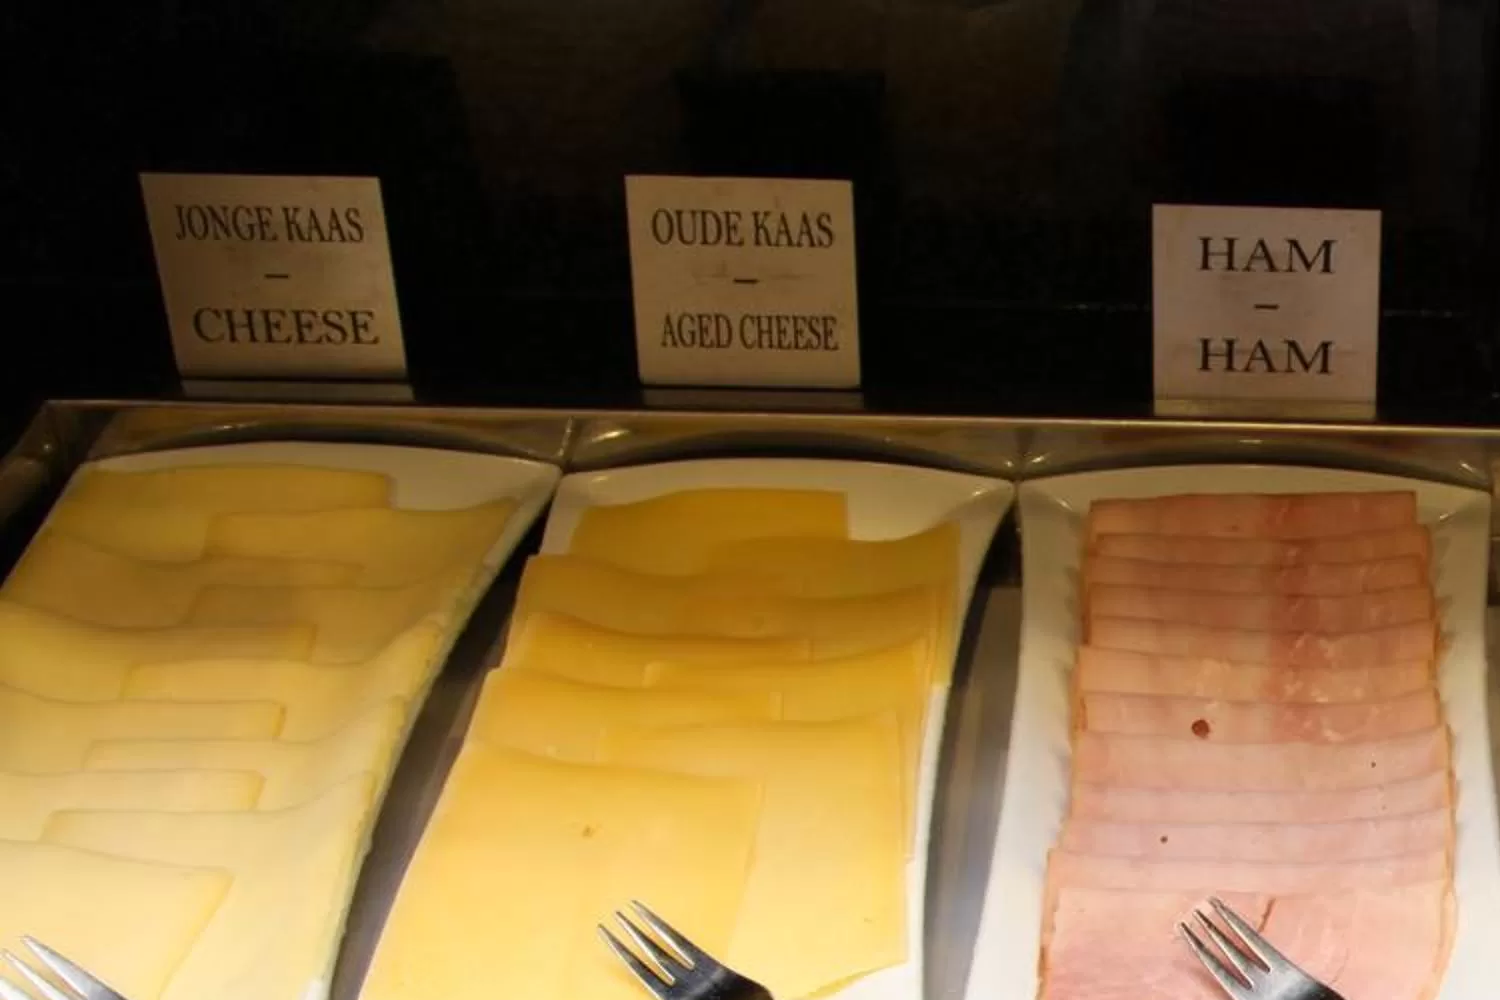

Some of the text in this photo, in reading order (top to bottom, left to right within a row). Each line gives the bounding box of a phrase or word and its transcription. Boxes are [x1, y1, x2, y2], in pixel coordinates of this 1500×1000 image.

[175, 204, 365, 244] JONGE KAAS
[651, 207, 835, 249] OUDE KAAS
[1199, 236, 1337, 275] HAM
[192, 307, 381, 346] CHEESE
[660, 311, 840, 352] AGED CHEESE
[1199, 337, 1333, 375] HAM
